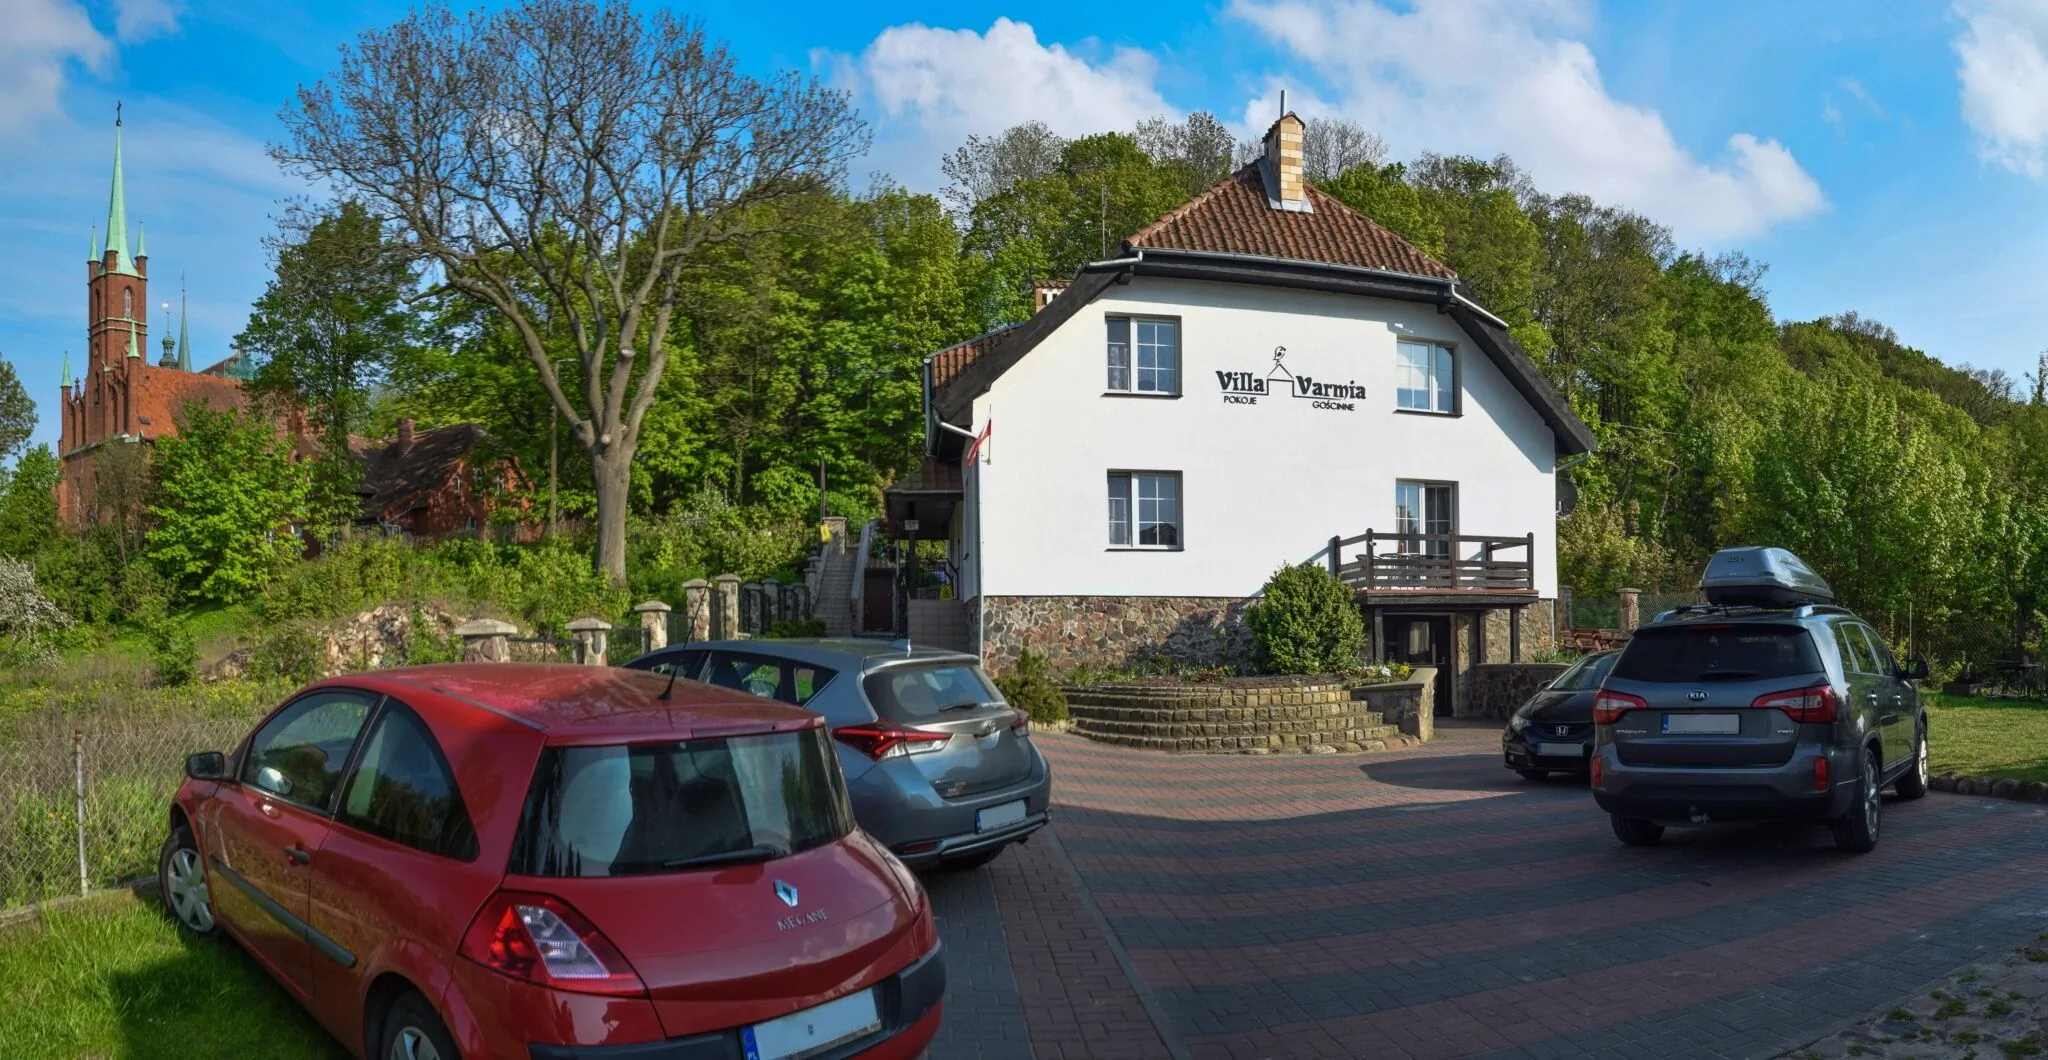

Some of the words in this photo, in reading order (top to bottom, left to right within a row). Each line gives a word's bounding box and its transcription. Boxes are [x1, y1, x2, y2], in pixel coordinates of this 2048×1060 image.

[1216, 371, 1265, 393] Villa
[1295, 375, 1366, 400] Varmia
[1223, 395, 1257, 405] POKOJE
[1312, 399, 1355, 411] GOŚCINNE
[1689, 692, 1706, 700] KIA
